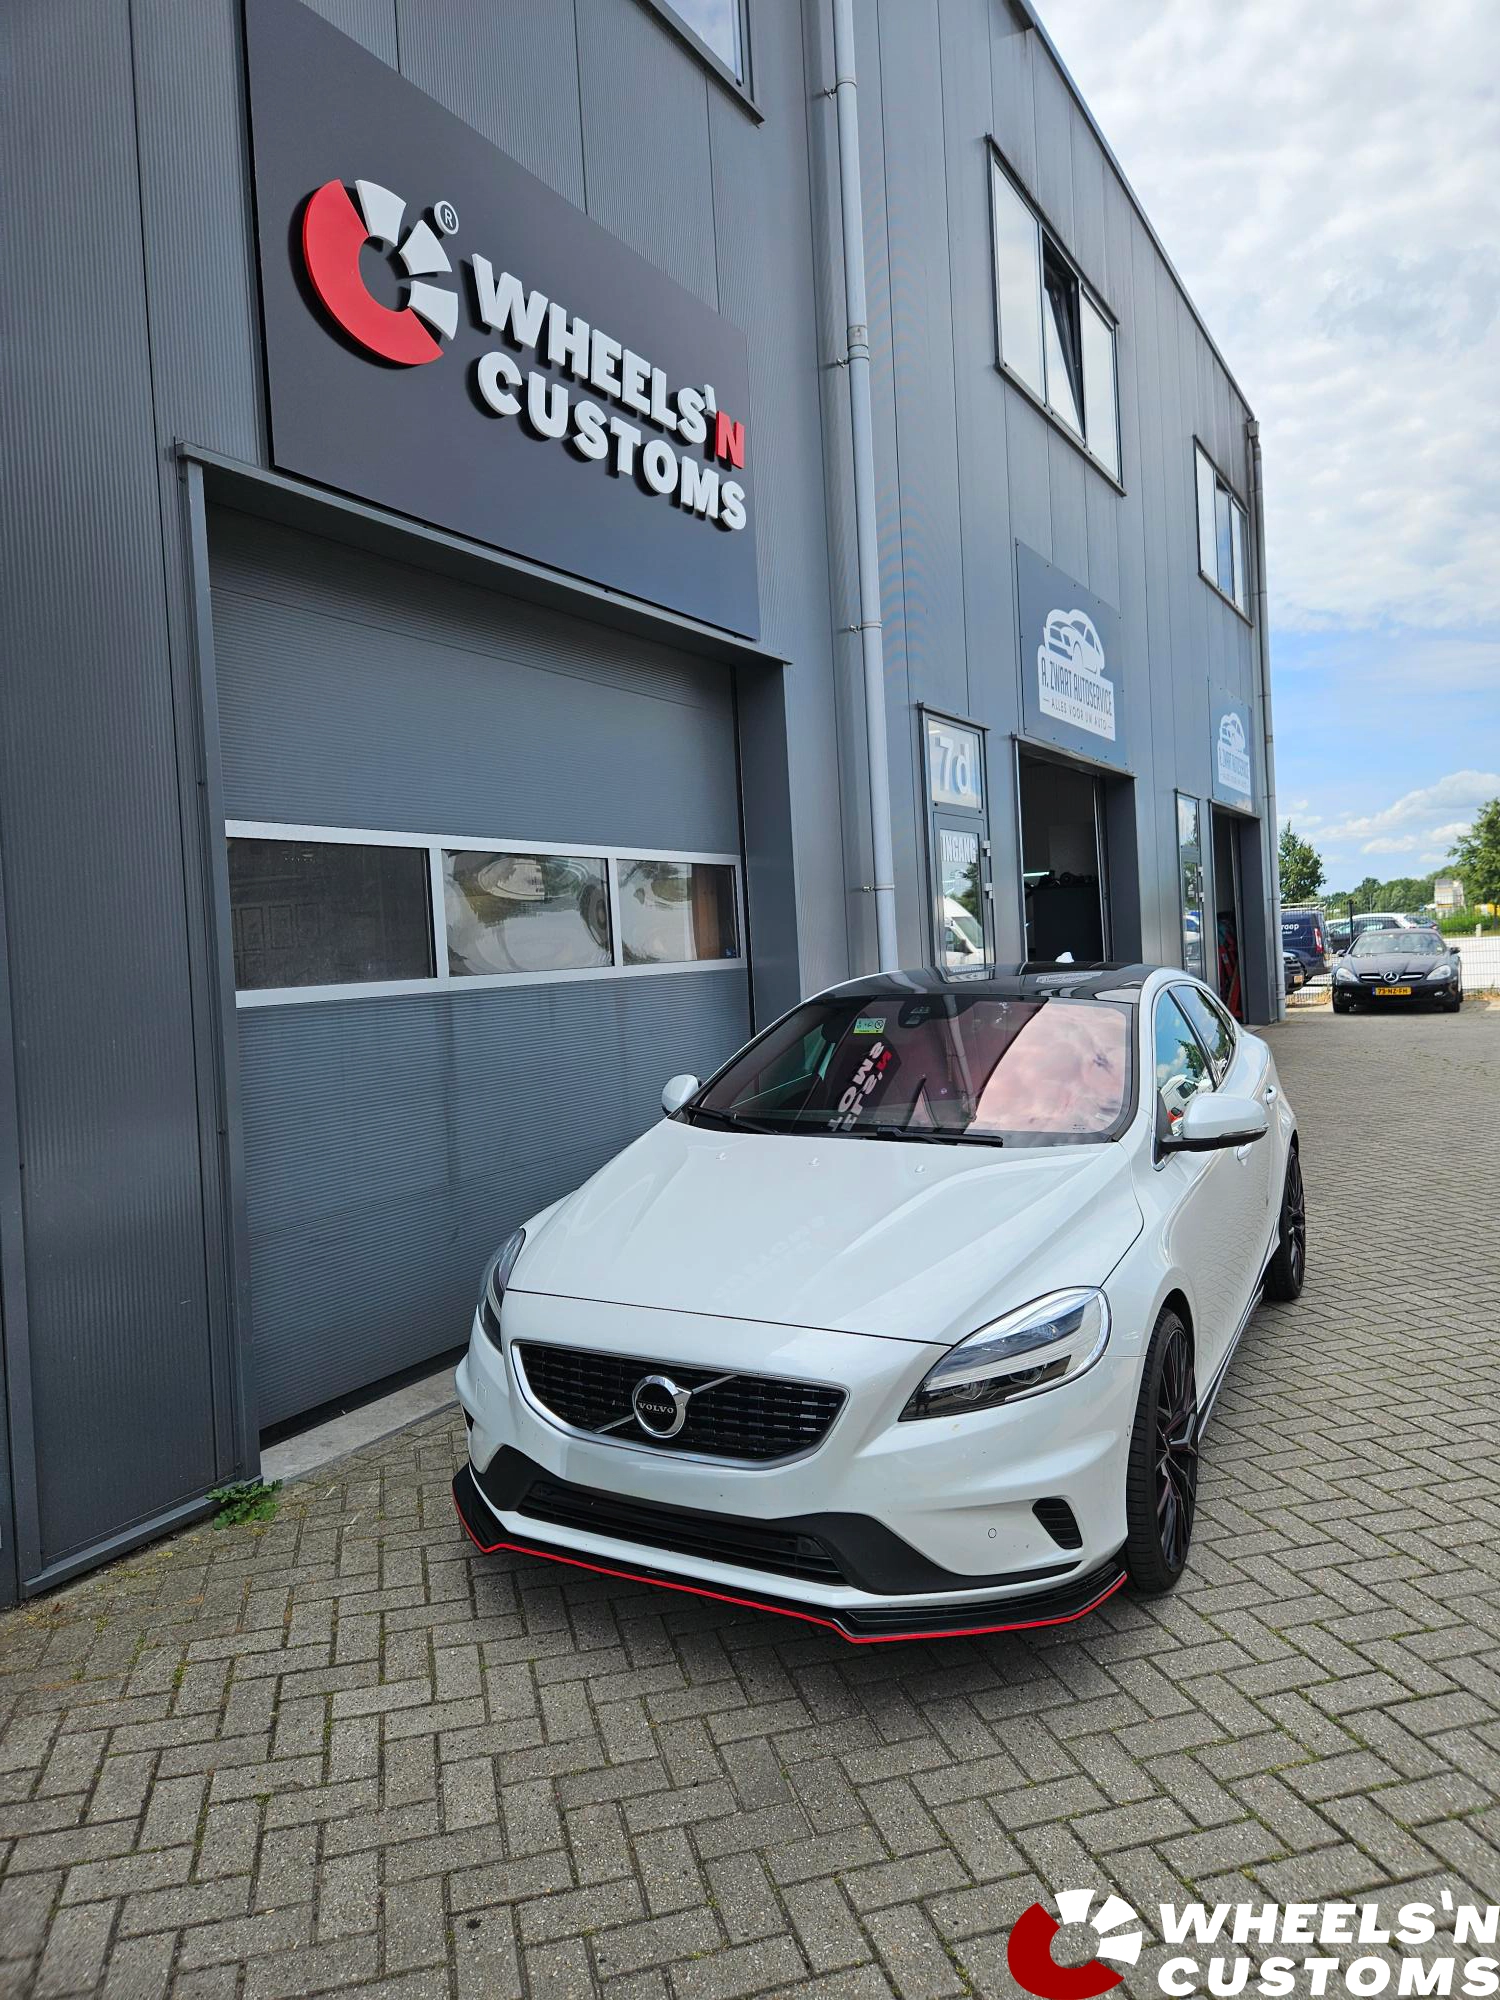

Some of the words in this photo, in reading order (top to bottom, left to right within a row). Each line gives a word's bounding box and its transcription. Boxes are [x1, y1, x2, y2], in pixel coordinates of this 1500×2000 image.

[472, 253, 745, 469] WHEELS'N
[478, 352, 747, 531] CUSTOMS
[1050, 661, 1072, 697] ZWART
[1073, 673, 1112, 716] AUTOSERVICE
[638, 1402, 674, 1413] VOLVO
